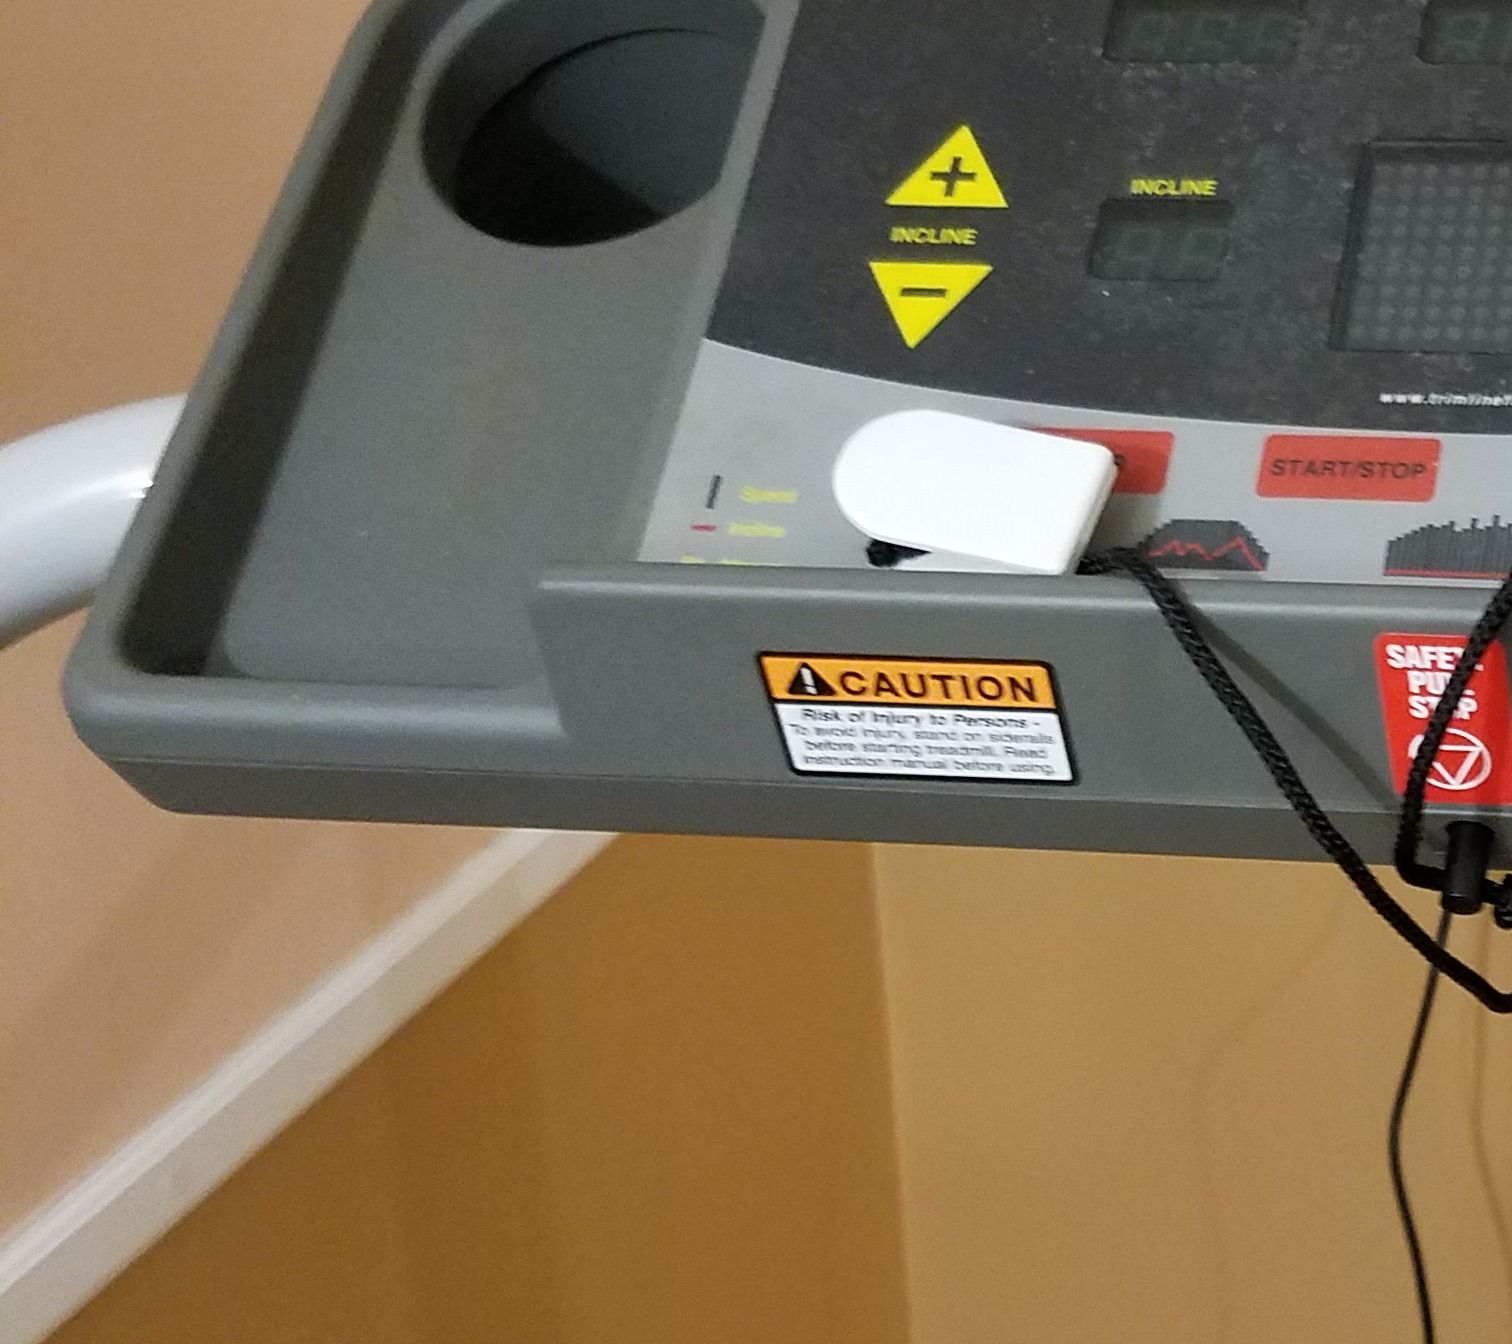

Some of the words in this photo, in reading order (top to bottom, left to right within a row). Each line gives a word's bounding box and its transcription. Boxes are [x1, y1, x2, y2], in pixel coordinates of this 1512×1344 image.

[1131, 179, 1218, 196] INCLINE
[889, 227, 978, 246] INCLINE
[1271, 459, 1427, 480] START/STOP
[1386, 644, 1484, 671] SAFE
[839, 670, 1037, 702] CAUTION
[802, 708, 841, 722] Risk
[848, 709, 865, 723] of
[929, 713, 946, 726] to
[954, 714, 1027, 729] Persons
